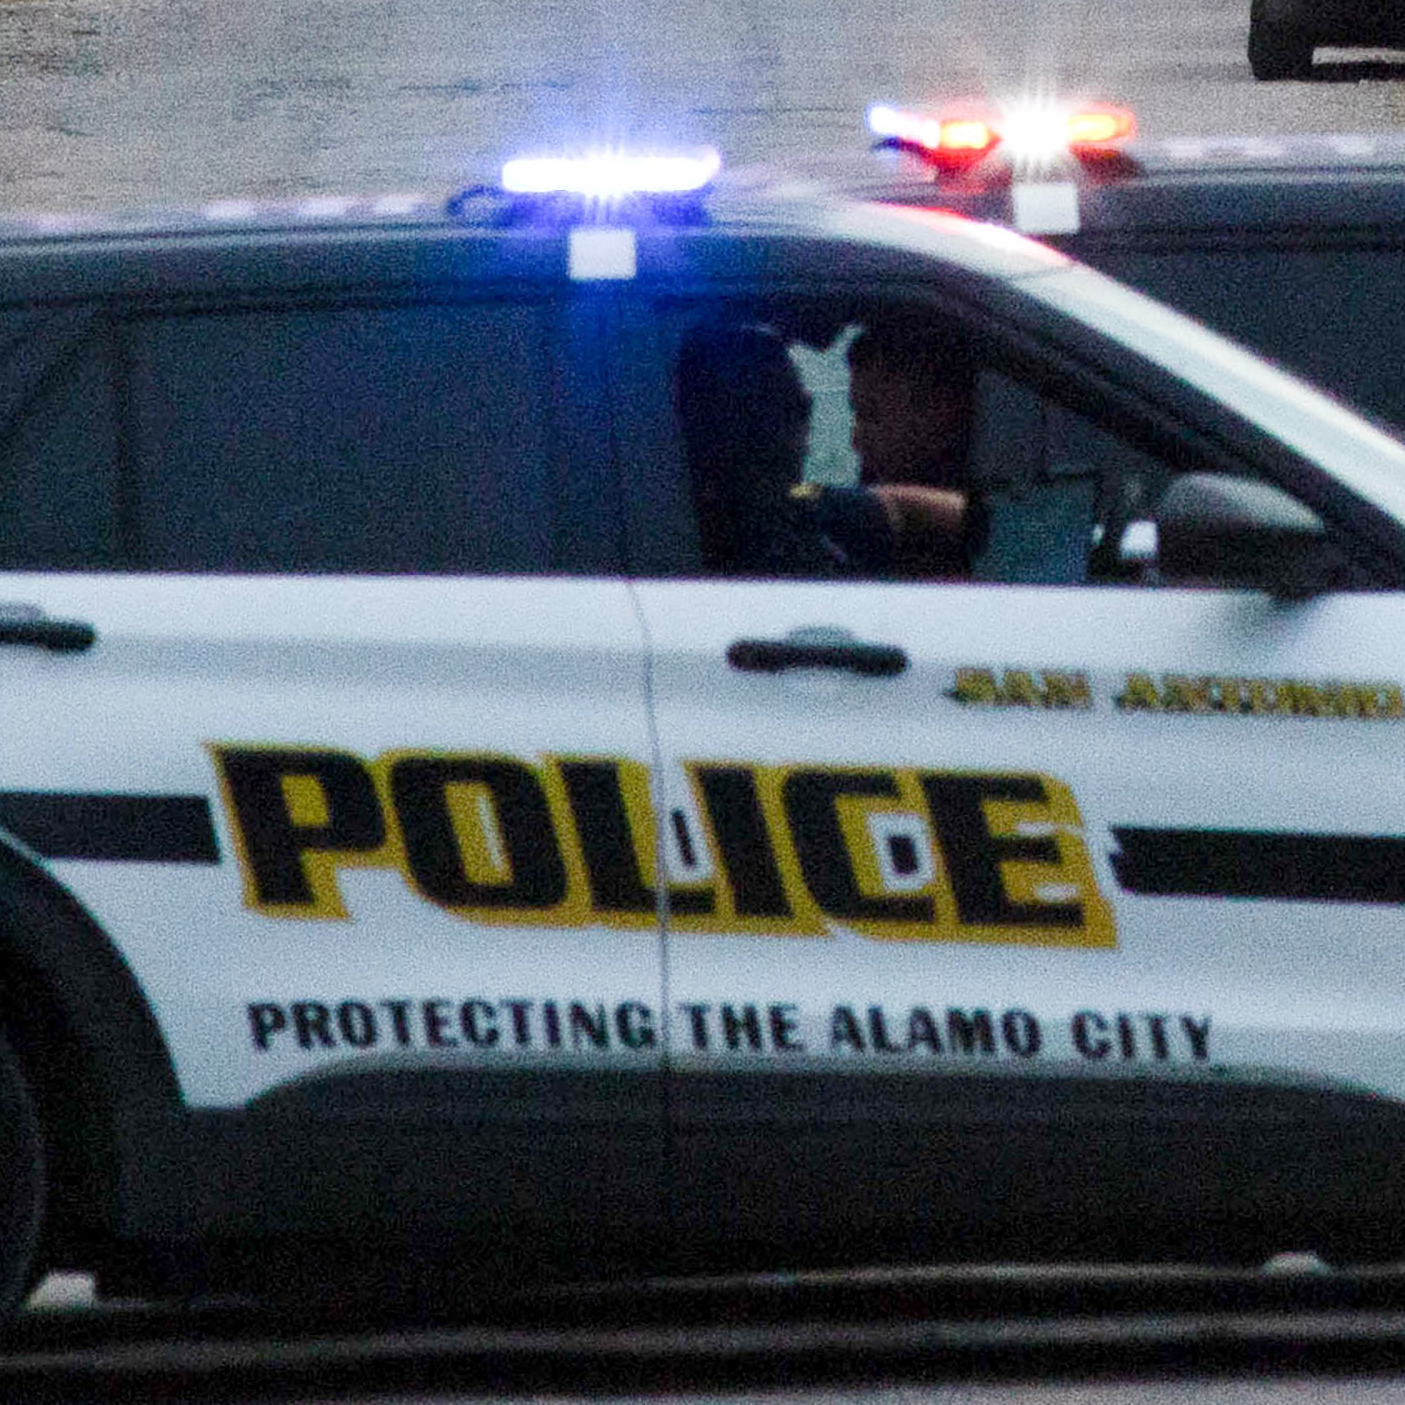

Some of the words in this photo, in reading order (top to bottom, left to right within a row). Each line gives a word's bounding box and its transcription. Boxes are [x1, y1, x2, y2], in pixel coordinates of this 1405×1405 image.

[203, 741, 1120, 949] POLICE
[247, 997, 658, 1052] PROTECTING
[682, 1003, 804, 1054] THE
[828, 1006, 1042, 1061] ALAMO
[1068, 1009, 1213, 1063] CITY
